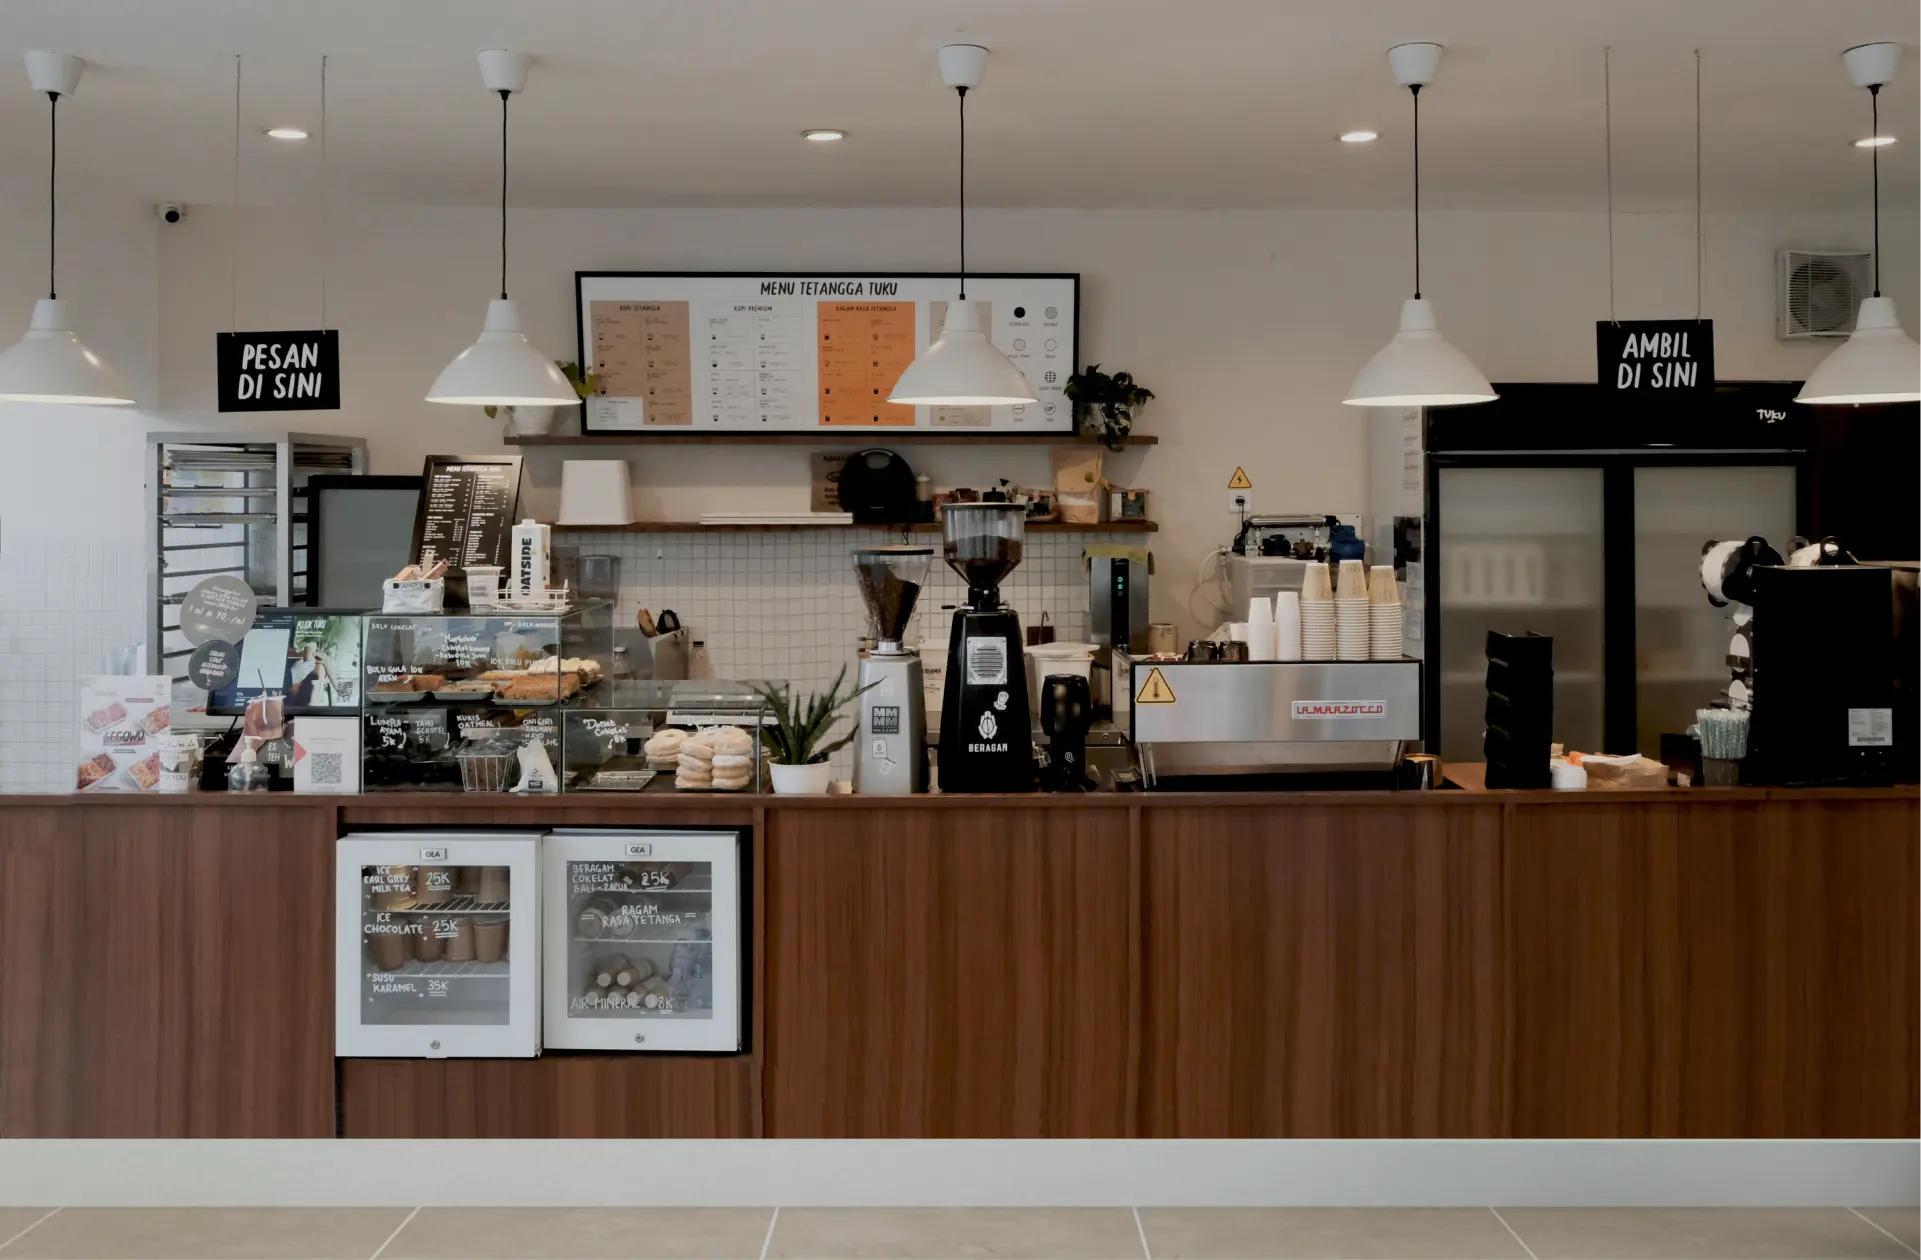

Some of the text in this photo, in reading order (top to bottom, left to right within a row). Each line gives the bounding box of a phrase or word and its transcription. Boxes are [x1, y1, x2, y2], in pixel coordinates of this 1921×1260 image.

[760, 281, 898, 296] MENU TETANGGA TUKU
[1622, 332, 1691, 359] AMBIL
[242, 342, 318, 370] PESAN
[1617, 361, 1698, 389] DI SINI
[238, 372, 322, 400] DI SINI
[520, 538, 532, 596] OATSIDE
[366, 665, 386, 674] BOLU
[388, 664, 407, 674] GULA
[377, 674, 398, 683] AREN
[370, 715, 402, 727] LUMPIA
[415, 719, 434, 727] TAHU
[456, 714, 480, 722] KUKIS
[522, 718, 553, 726] ONIGIRI
[458, 720, 495, 729] OATMEAL
[379, 726, 403, 736] AYAM
[268, 742, 277, 751] ES
[968, 742, 1008, 752] BERAGAM
[268, 753, 281, 762] TEH
[376, 866, 391, 875] ICE
[572, 864, 614, 873] BERAGAM
[364, 874, 410, 884] EARL GREY
[425, 872, 450, 886] 25K
[572, 873, 614, 883] COKELAT
[641, 871, 670, 886] 25K
[371, 884, 411, 893] MILK TEA
[621, 905, 658, 916] RAGAM
[376, 913, 391, 922] ICE
[602, 914, 681, 927] RASA TETANGA
[364, 924, 424, 935] CHOCOLATE
[433, 919, 459, 932] 25K
[372, 973, 395, 982] SUSU
[373, 983, 417, 993] KARAMEL
[428, 980, 448, 991] 35K
[570, 995, 674, 1009] AIR MINERAL 8K
